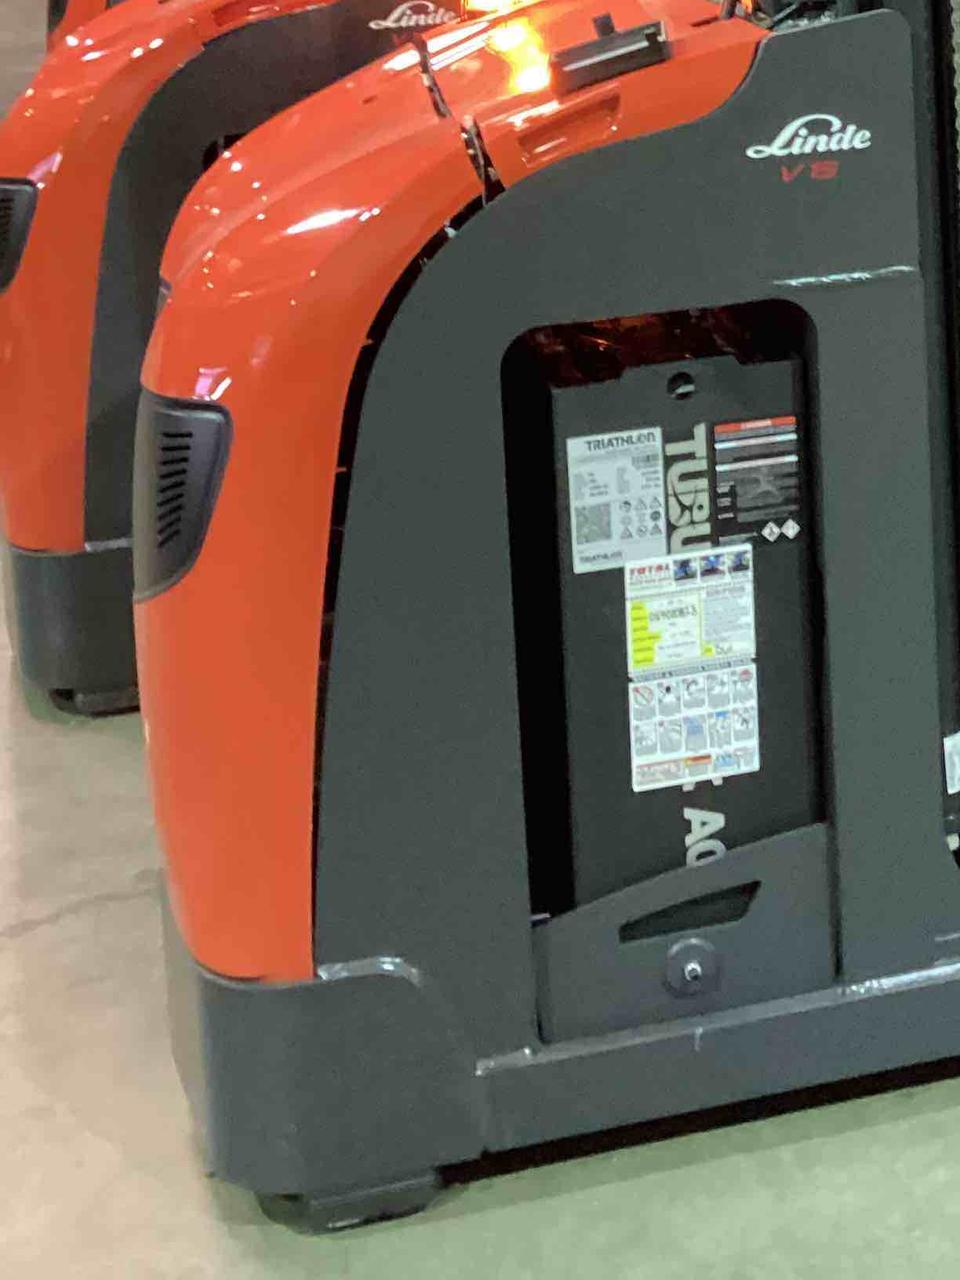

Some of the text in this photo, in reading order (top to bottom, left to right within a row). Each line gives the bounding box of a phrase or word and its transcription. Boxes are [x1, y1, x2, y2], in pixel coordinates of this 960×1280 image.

[368, 0, 458, 30] Linde
[746, 113, 872, 158] Linde
[665, 422, 712, 554] TUBU
